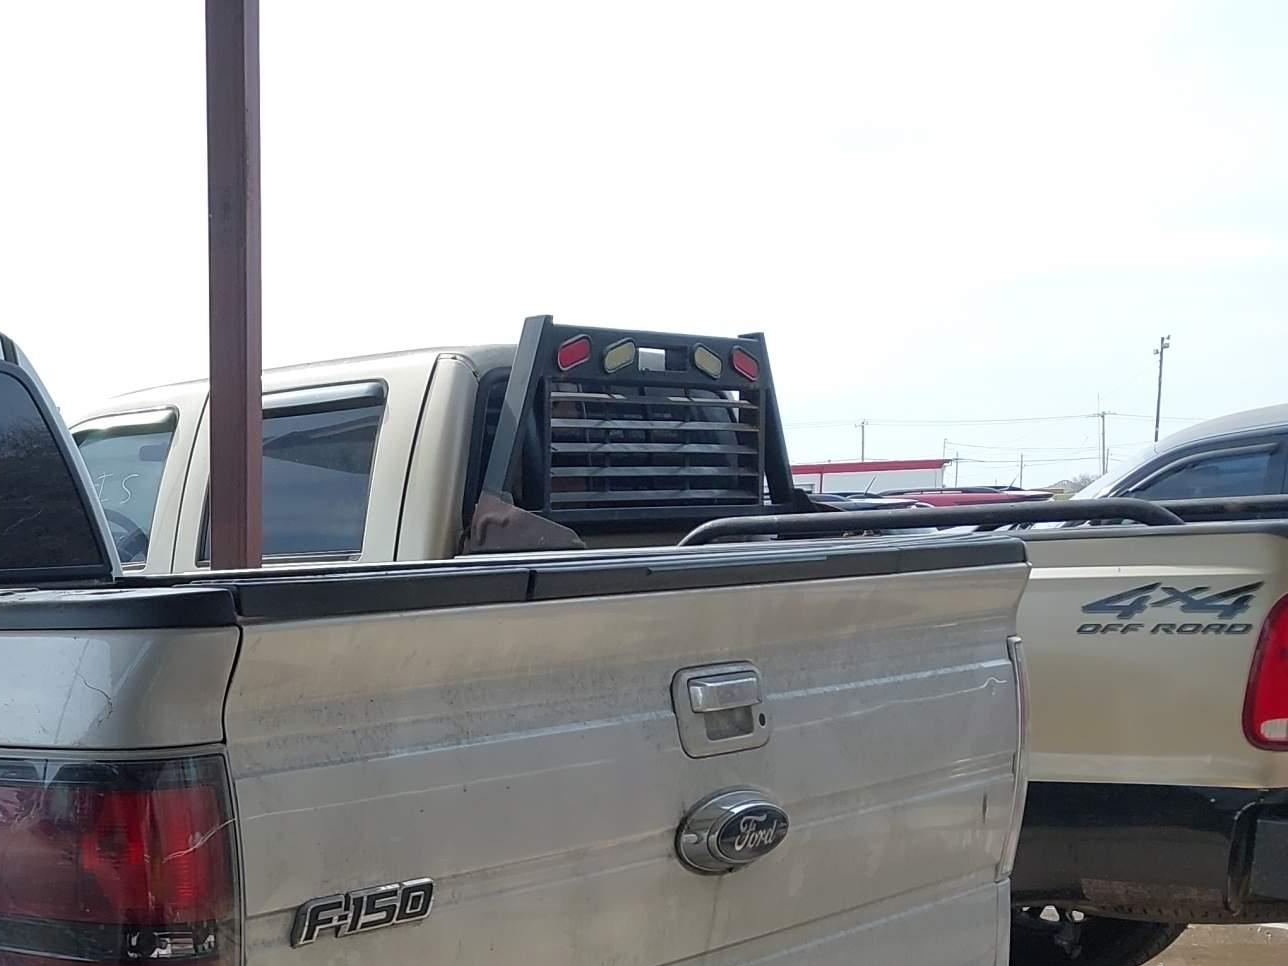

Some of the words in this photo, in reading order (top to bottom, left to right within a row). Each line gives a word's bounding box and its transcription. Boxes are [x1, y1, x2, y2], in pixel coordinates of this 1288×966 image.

[1076, 623, 1145, 635] OFF
[1149, 623, 1254, 635] ROAD
[734, 813, 778, 851] Ford
[291, 877, 434, 949] F-150
